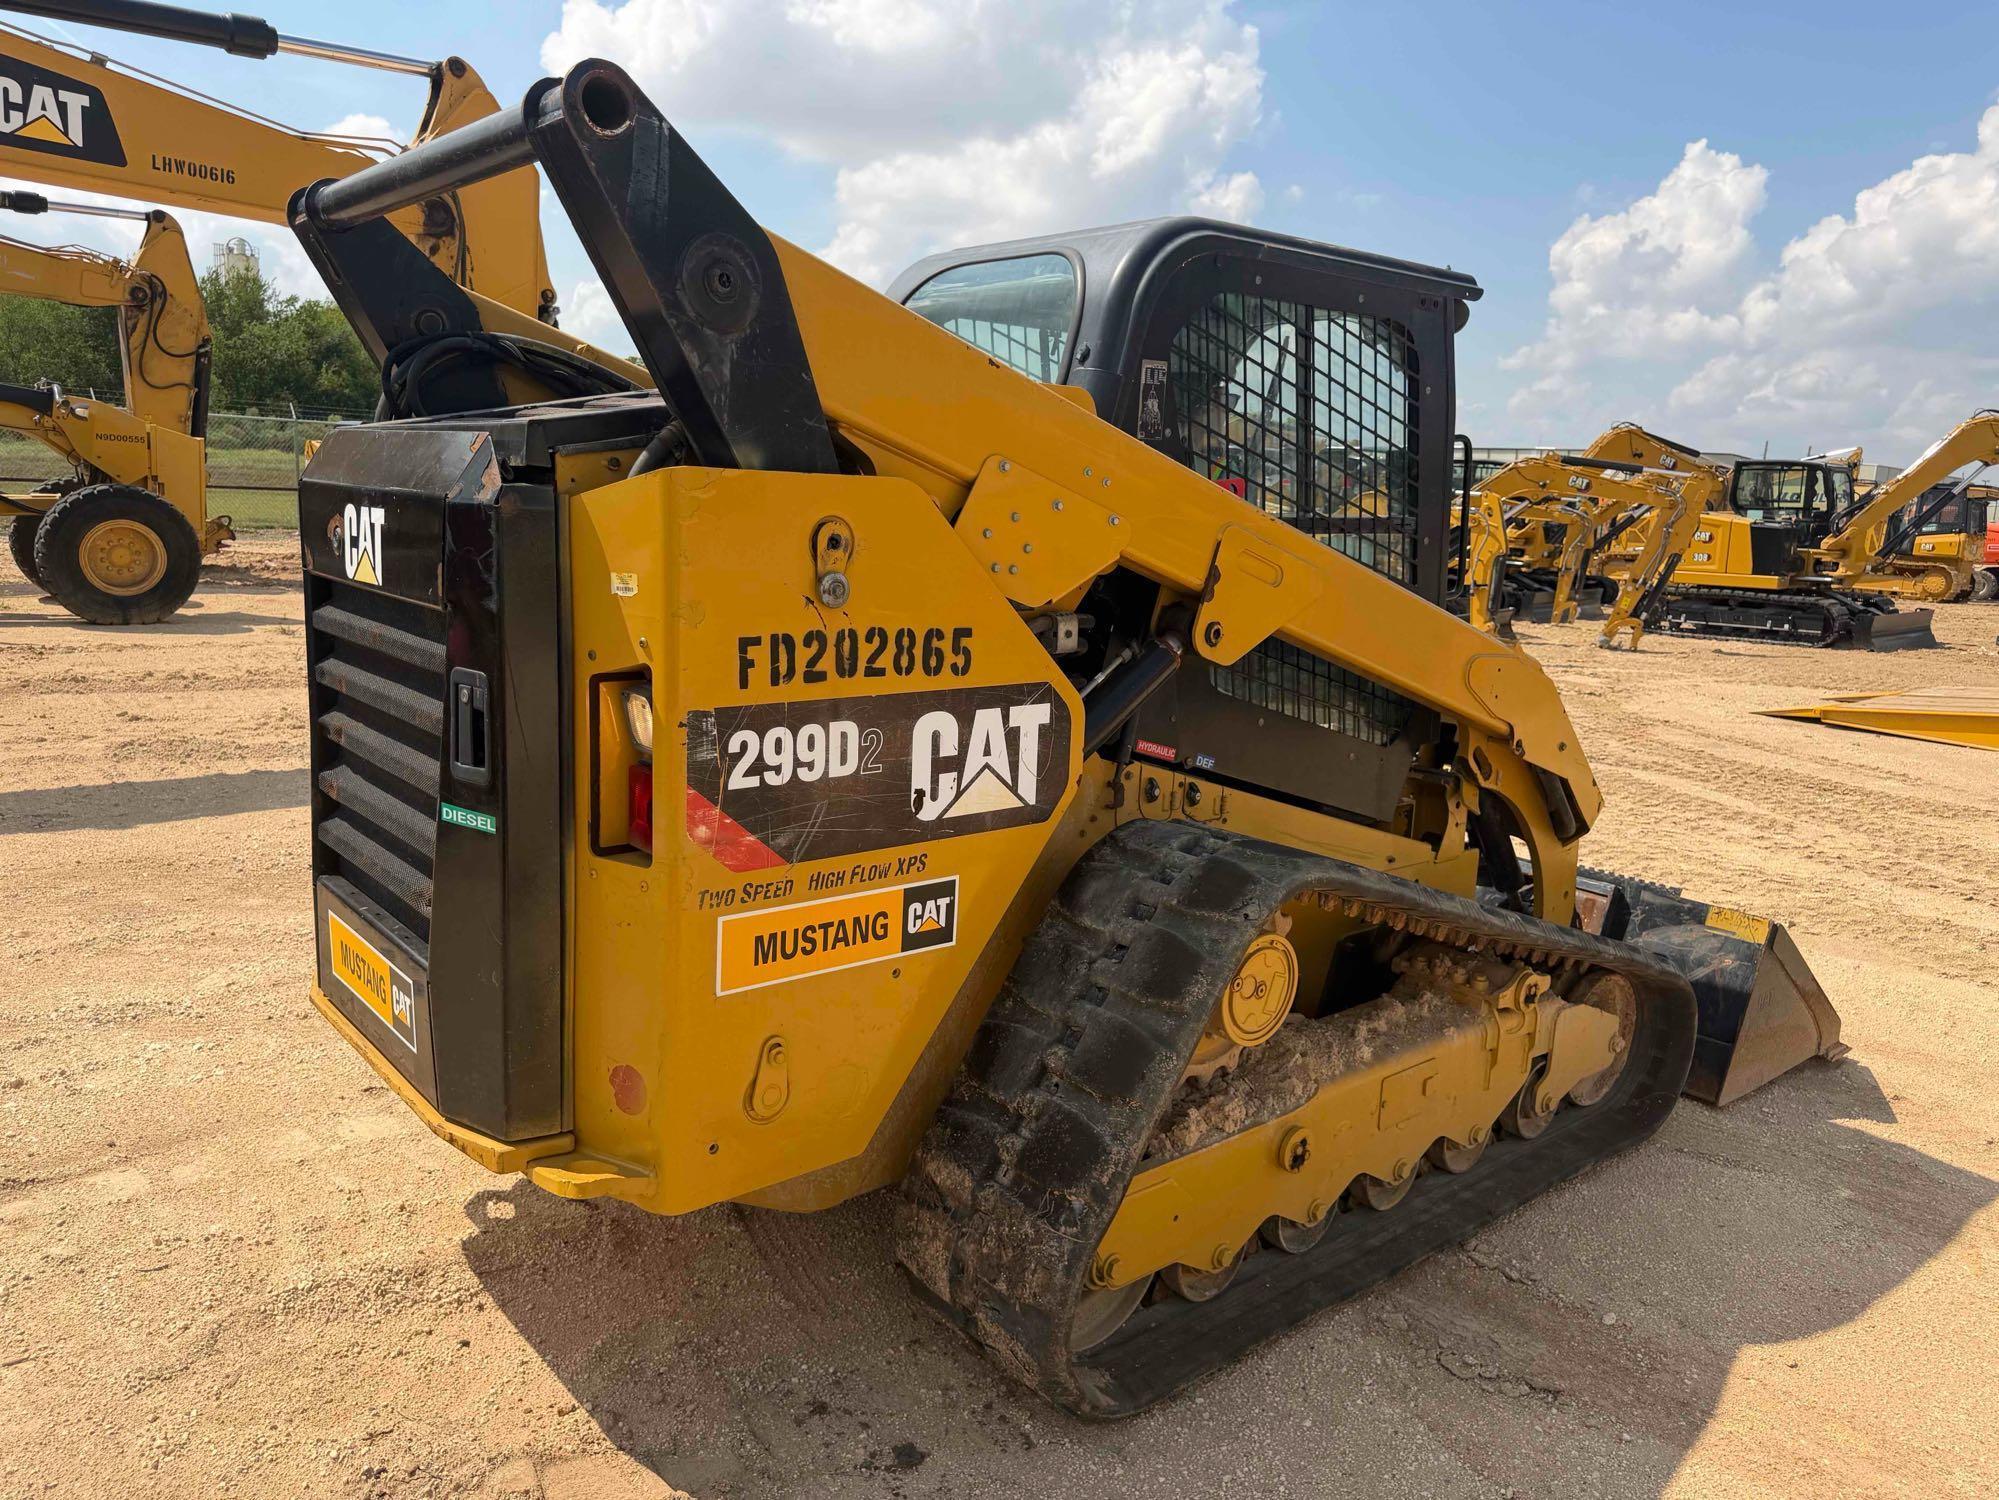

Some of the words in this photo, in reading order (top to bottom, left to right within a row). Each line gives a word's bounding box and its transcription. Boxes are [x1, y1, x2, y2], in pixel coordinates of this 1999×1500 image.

[0, 75, 90, 148] CAT
[151, 154, 236, 185] LHW00616
[95, 432, 146, 444] N9D00555
[1659, 454, 1675, 470] CAT
[1568, 475, 1590, 490] CAT
[343, 503, 385, 586] CAT
[1694, 531, 1711, 542] CAT
[1921, 543, 1934, 551] CAT
[738, 627, 973, 689] FD202865
[1138, 741, 1177, 758] HYDRAULIC
[727, 720, 884, 790] 299D2
[911, 703, 1051, 821] CAT
[1196, 755, 1215, 769] DEF
[443, 807, 496, 832] DIESEL
[895, 853, 928, 875] XPS
[753, 911, 889, 966] MUSTANG
[908, 897, 950, 934] CAT
[340, 940, 386, 1005] MUSTANG
[392, 984, 410, 1028] CAT
